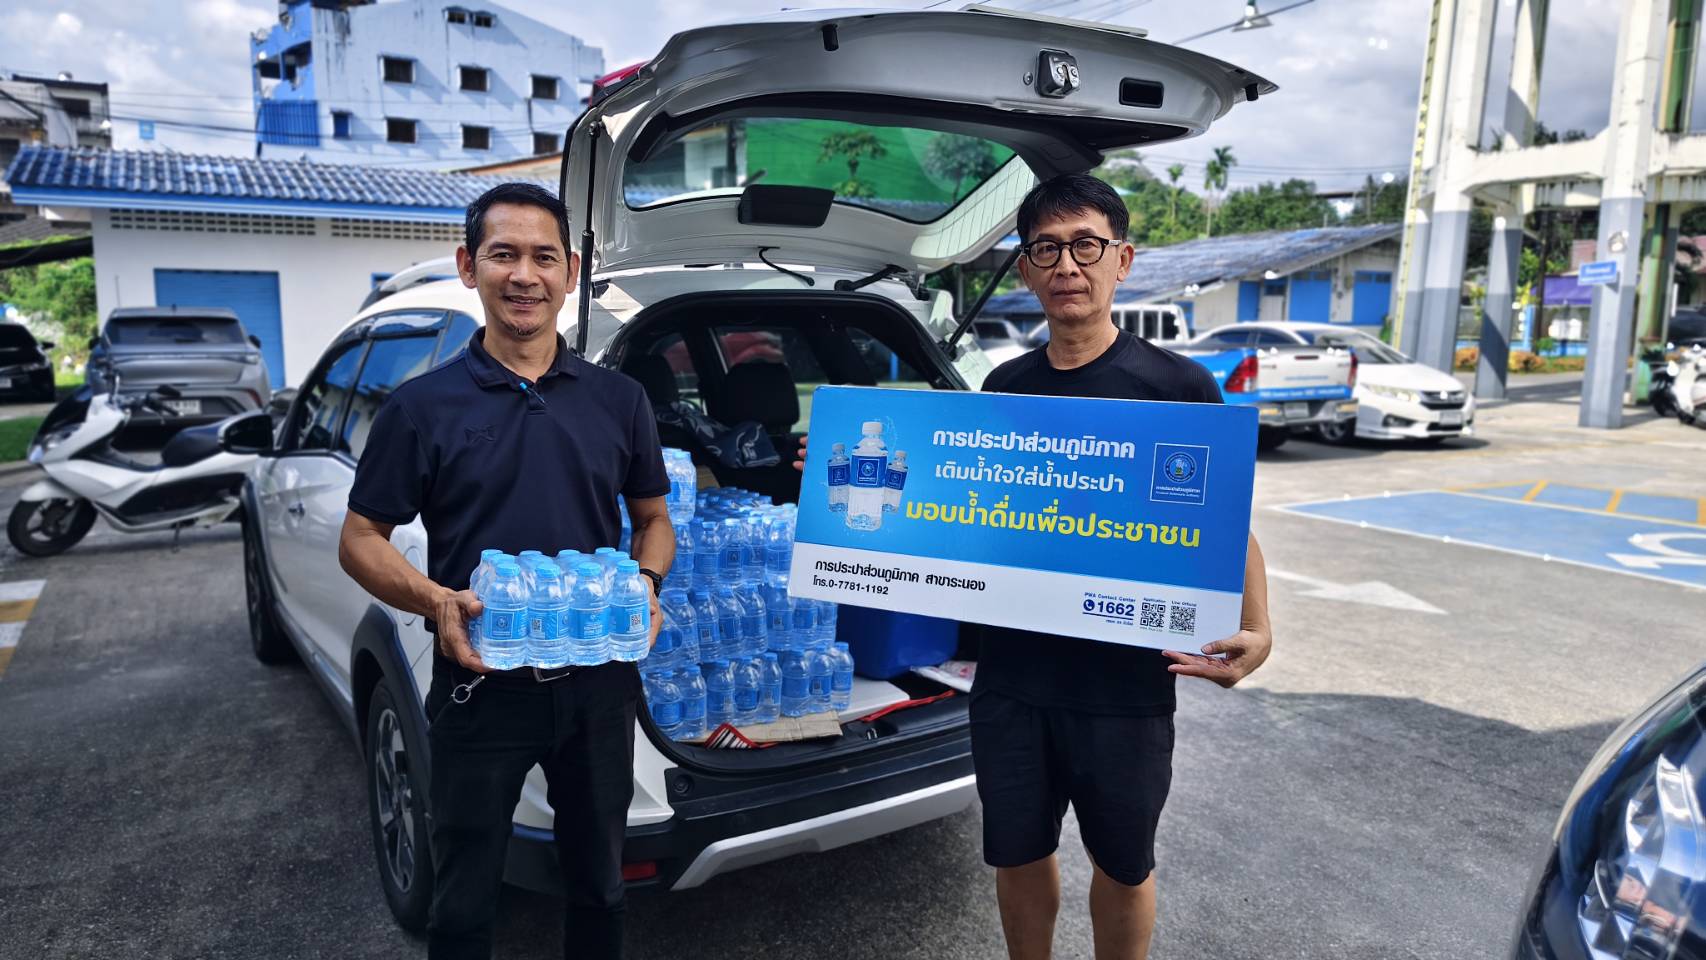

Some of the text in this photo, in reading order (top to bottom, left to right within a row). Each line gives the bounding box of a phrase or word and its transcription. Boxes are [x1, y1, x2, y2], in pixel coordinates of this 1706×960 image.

[933, 430, 1136, 460] การประปาส่วนภูมิภาค
[935, 456, 1125, 492] เติมน้ำใจใส่น้ำประปา
[905, 491, 1200, 547] มอบน้ำดื่มเพื่อประชาชน
[812, 575, 889, 595] โทร.0-7781-1192
[815, 560, 986, 591] การประปาส่วนภูมิภาค สาขาระนอง
[1097, 601, 1135, 616] 1662
